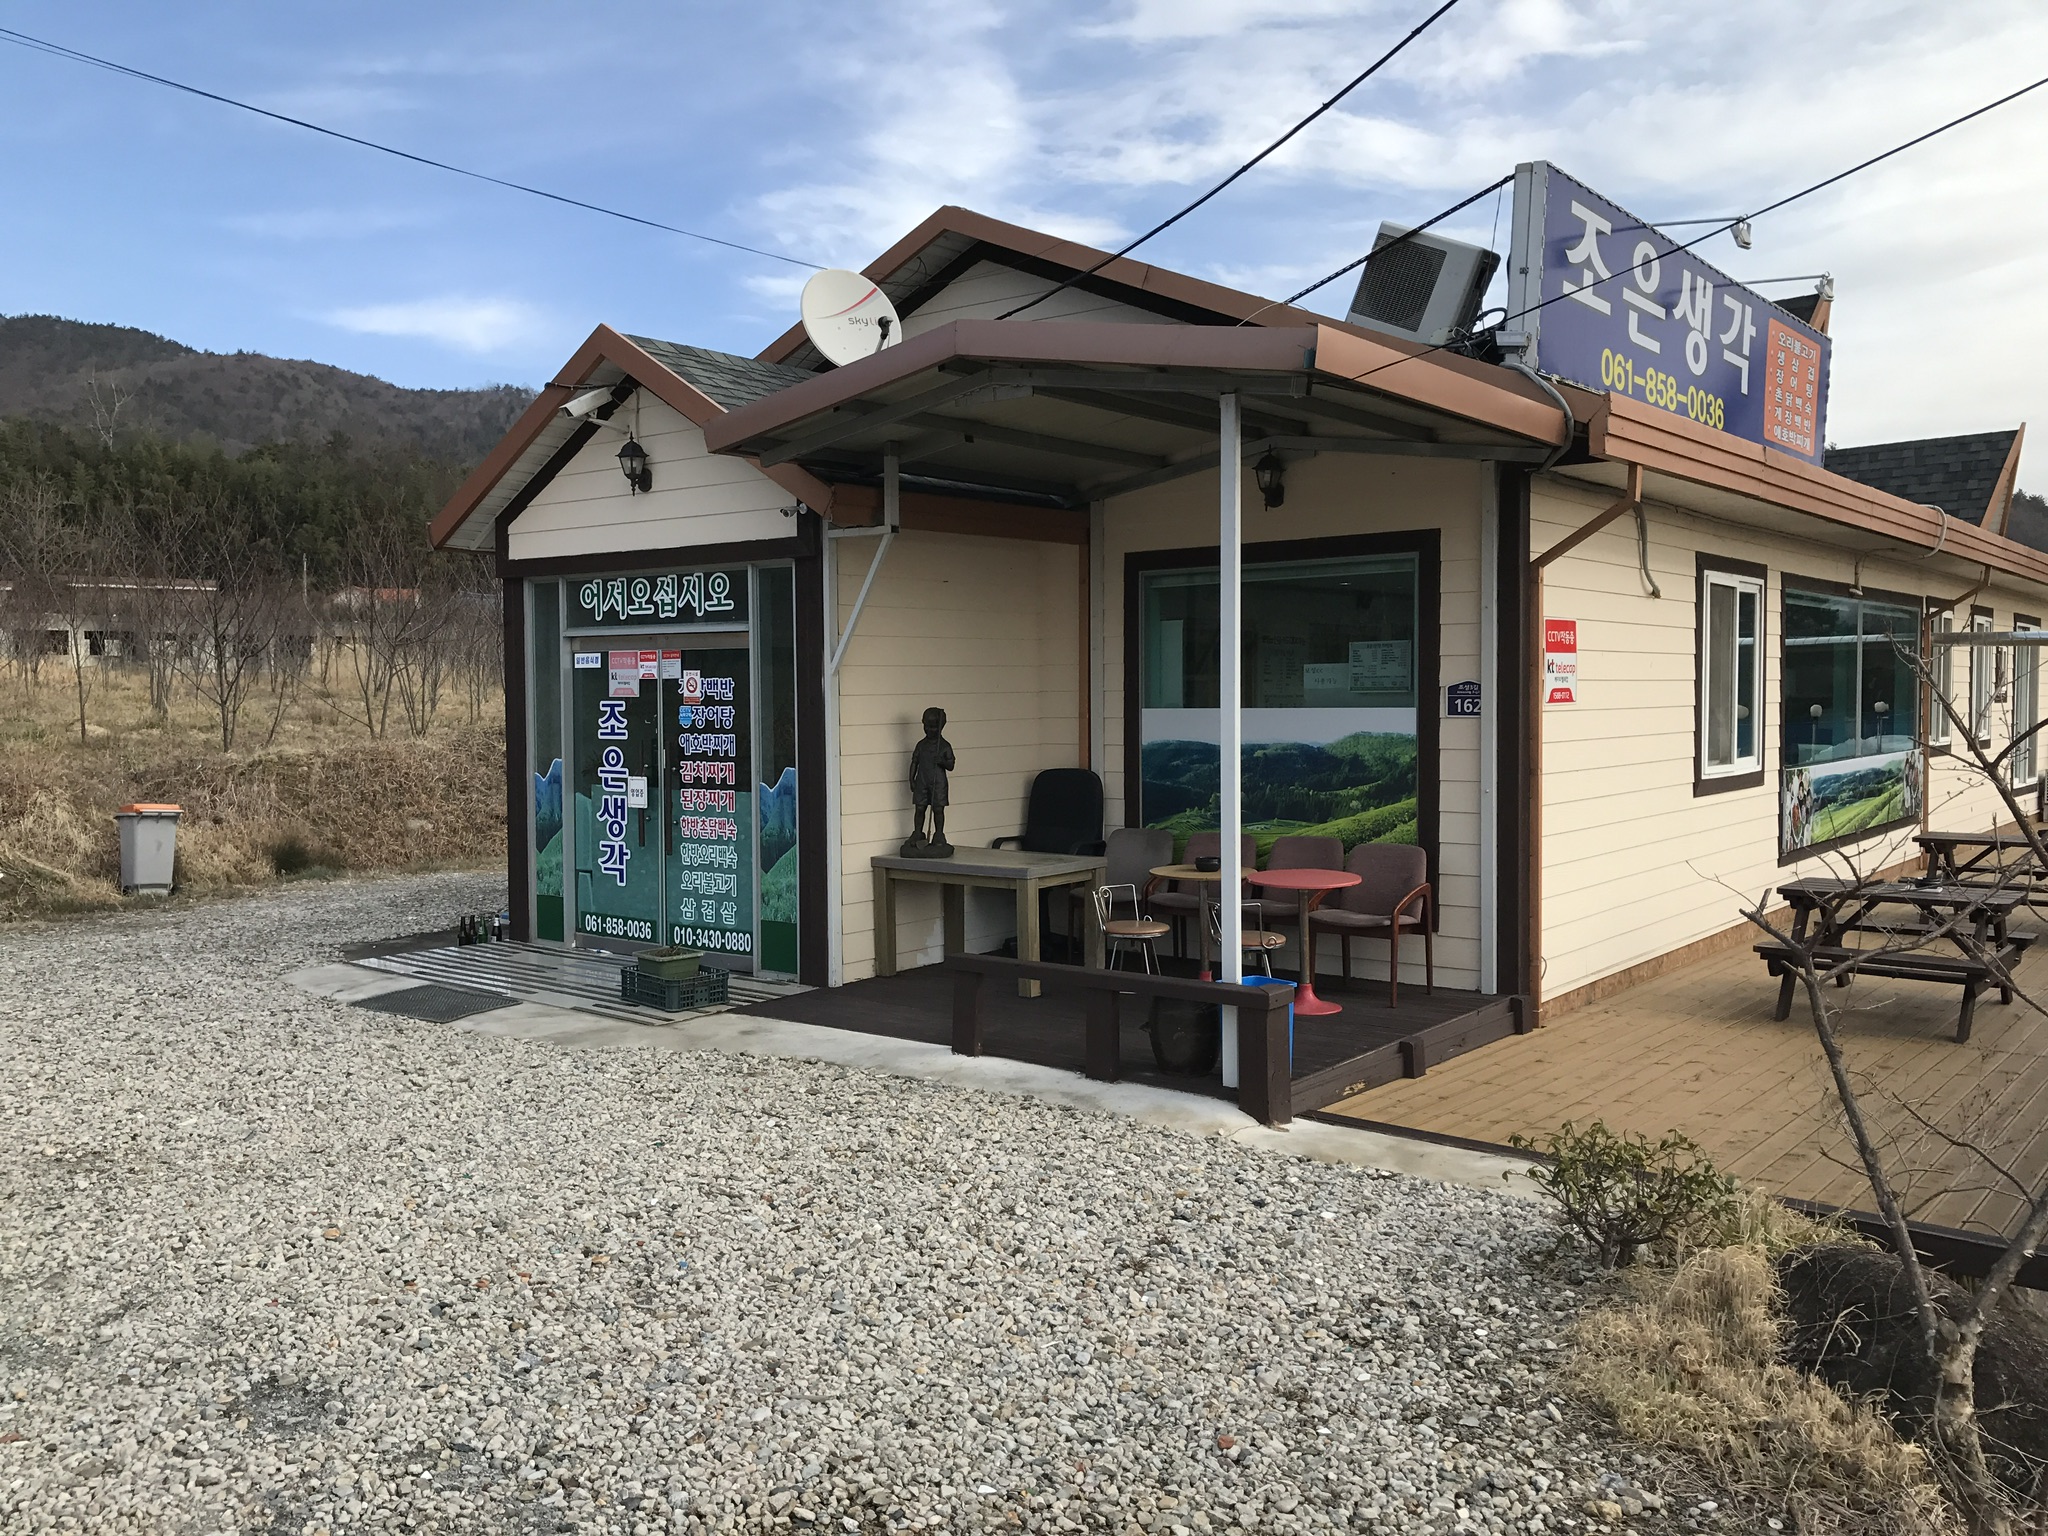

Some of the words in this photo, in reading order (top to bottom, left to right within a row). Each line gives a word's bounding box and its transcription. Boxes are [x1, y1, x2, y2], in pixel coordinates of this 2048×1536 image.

[1562, 199, 1757, 396] 조은생각
[1777, 332, 1816, 364] 오리불고기
[1601, 348, 1725, 430] 061-858-0036
[580, 571, 735, 621] 어서오십시오
[1547, 630, 1575, 645] CCTV작동중
[1546, 659, 1555, 674] kt
[1555, 662, 1576, 676] telecop
[1454, 698, 1482, 713] 162
[678, 733, 737, 757] 애호박찌개
[680, 760, 736, 786] 김치찌개
[597, 700, 630, 887] 조은생각
[680, 788, 736, 814] 된장찌개
[680, 815, 738, 841] 한방촌닭백숙
[680, 842, 738, 870] 한방오리백숙
[680, 870, 738, 898] 오리불고기
[585, 913, 652, 940] 061-858-0036
[673, 925, 752, 952] 010-3430-0880
